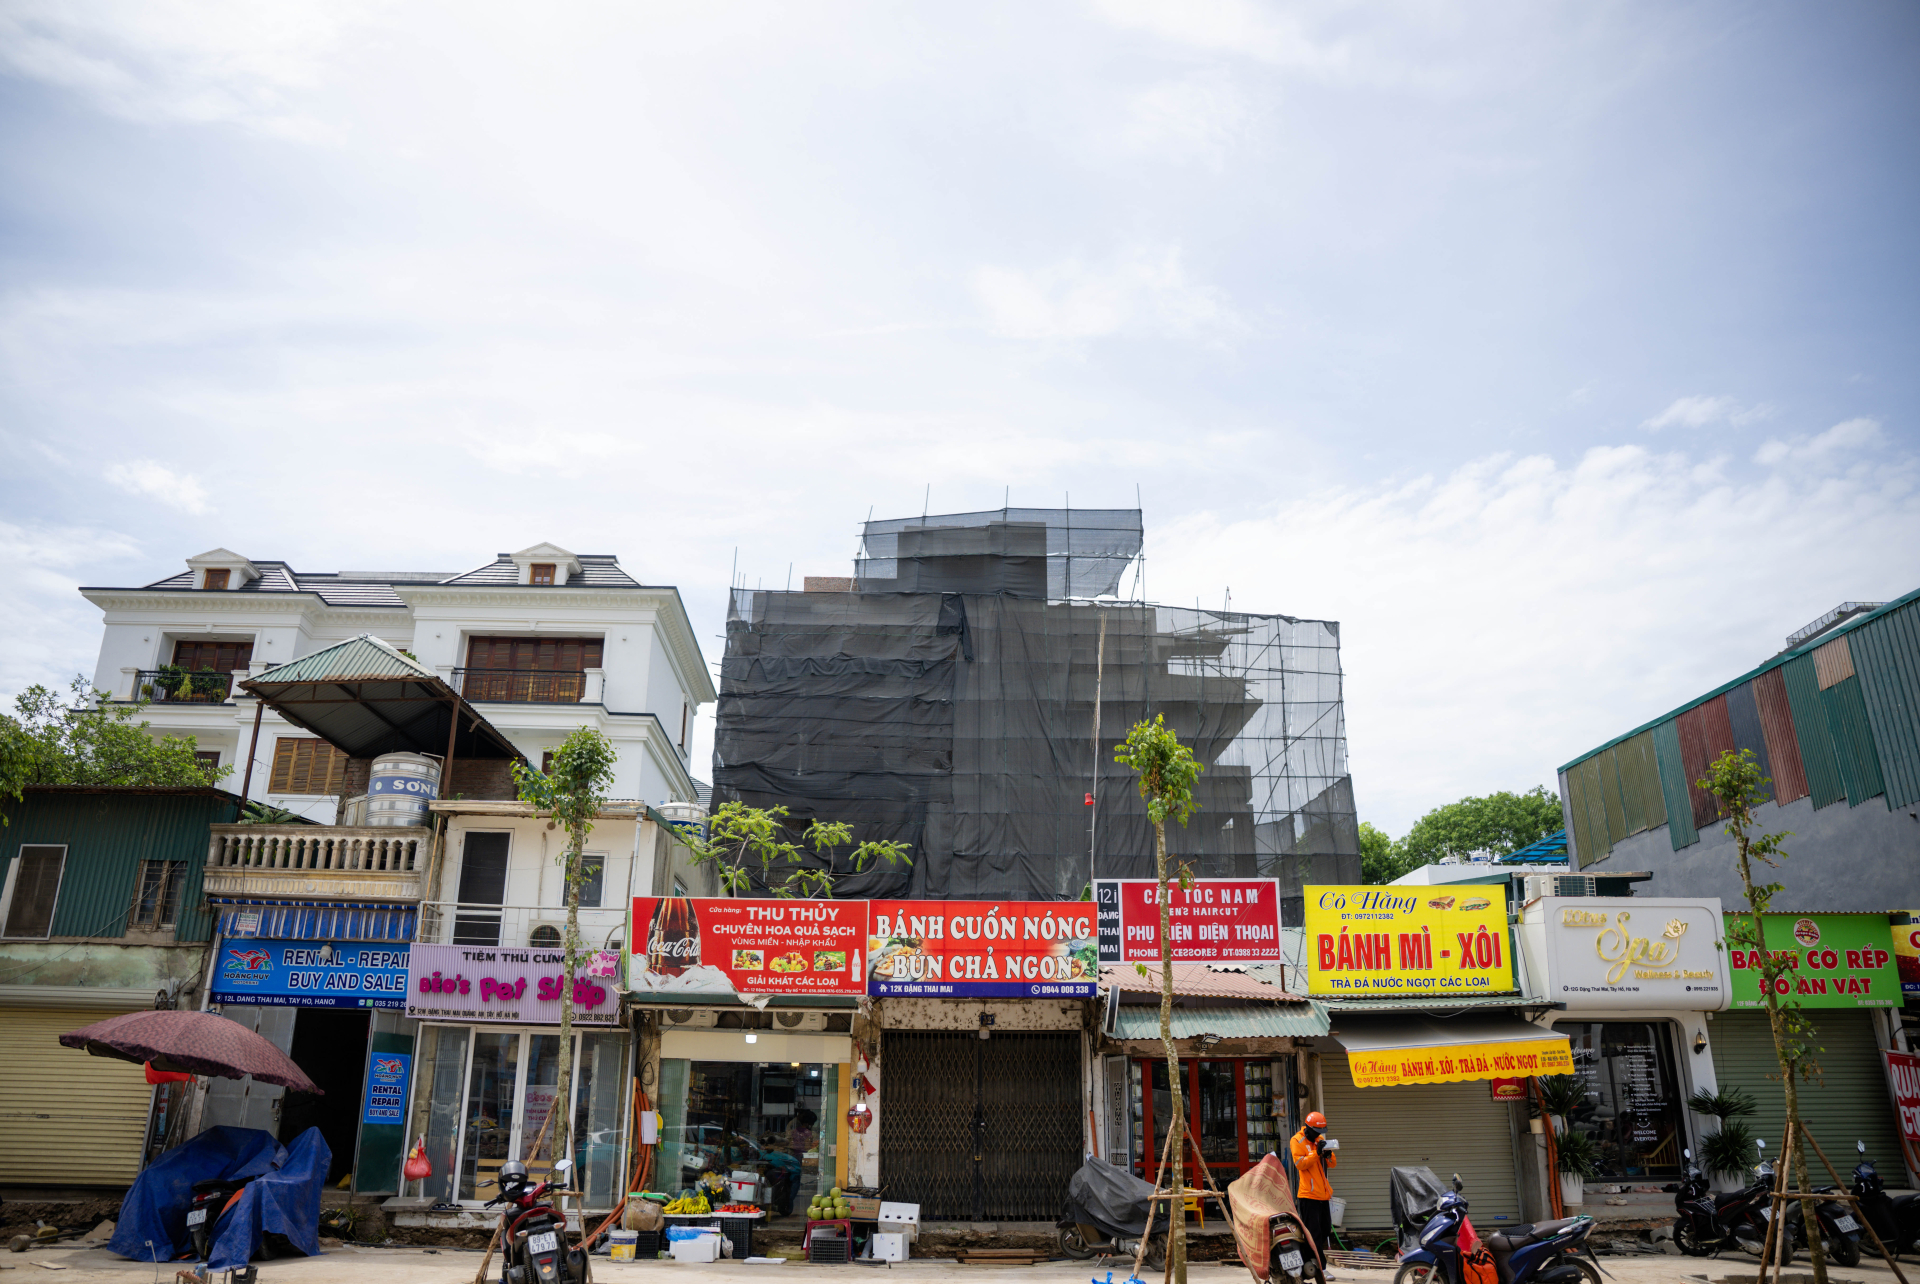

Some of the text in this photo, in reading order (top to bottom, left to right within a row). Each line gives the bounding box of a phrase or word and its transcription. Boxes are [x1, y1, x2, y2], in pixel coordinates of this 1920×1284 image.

[393, 780, 431, 794] SƠN
[1184, 884, 1214, 904] TÓC
[1221, 889, 1259, 904] NAM
[1319, 891, 1417, 915] Cô Hằng
[746, 903, 839, 921] THU THỦY
[1098, 908, 1119, 921] ĐẶNG
[1169, 906, 1238, 916] EN'S HAIRCUT
[876, 906, 1091, 940] BÁNH CUỐN NÓNG
[712, 923, 856, 938] CHUYÊN HOA QUẢ SẠCH
[1099, 927, 1120, 936] THAI
[1128, 926, 1155, 943] PHỤ
[1169, 922, 1192, 943] IỆN
[646, 937, 700, 958] Coca-Cola
[732, 938, 755, 946] VÙNG
[786, 938, 810, 948] NHẬP
[813, 937, 837, 947] KHẨU
[1100, 944, 1118, 953] MAI
[1318, 925, 1502, 971] BÁNH MÌ XÔI
[1596, 912, 1672, 984] Spa
[283, 949, 344, 966] RENTAL
[463, 952, 496, 964] TIỆM
[501, 951, 529, 963] THỦ
[1129, 949, 1158, 957] PHONE
[1252, 948, 1260, 956] 33
[1261, 948, 1279, 956] 2222
[1807, 946, 1838, 970] CỜ
[1846, 943, 1889, 970] RẾP
[893, 946, 1073, 980] BÚN CHẢ NGON
[224, 972, 251, 980] HOÀNG
[288, 972, 406, 991] BUY AND SALE
[747, 975, 838, 988] GIẢI KHÁT CÁC LOẠI
[1634, 969, 1672, 980] Wellness
[1682, 970, 1714, 980] Beauty
[890, 983, 953, 994] 12K ĐẶNG THAI MAI
[1042, 986, 1089, 994] 0944 008 338
[1330, 976, 1490, 990] TRÀ ĐÁ NƯỚC NGỌT CÁC LOẠI
[1831, 975, 1871, 999] VẶT
[1401, 1052, 1538, 1077] BÁNH MÌ XÔI TRÀ ĐÁ NƯỚC NGỌT
[1891, 1059, 1920, 1101] QUÁ
[372, 1085, 402, 1095] RENTAL
[371, 1097, 400, 1107] REPAIR
[379, 1109, 388, 1117] AND
[388, 1109, 400, 1117] SALE
[533, 1234, 552, 1244] 89-E1
